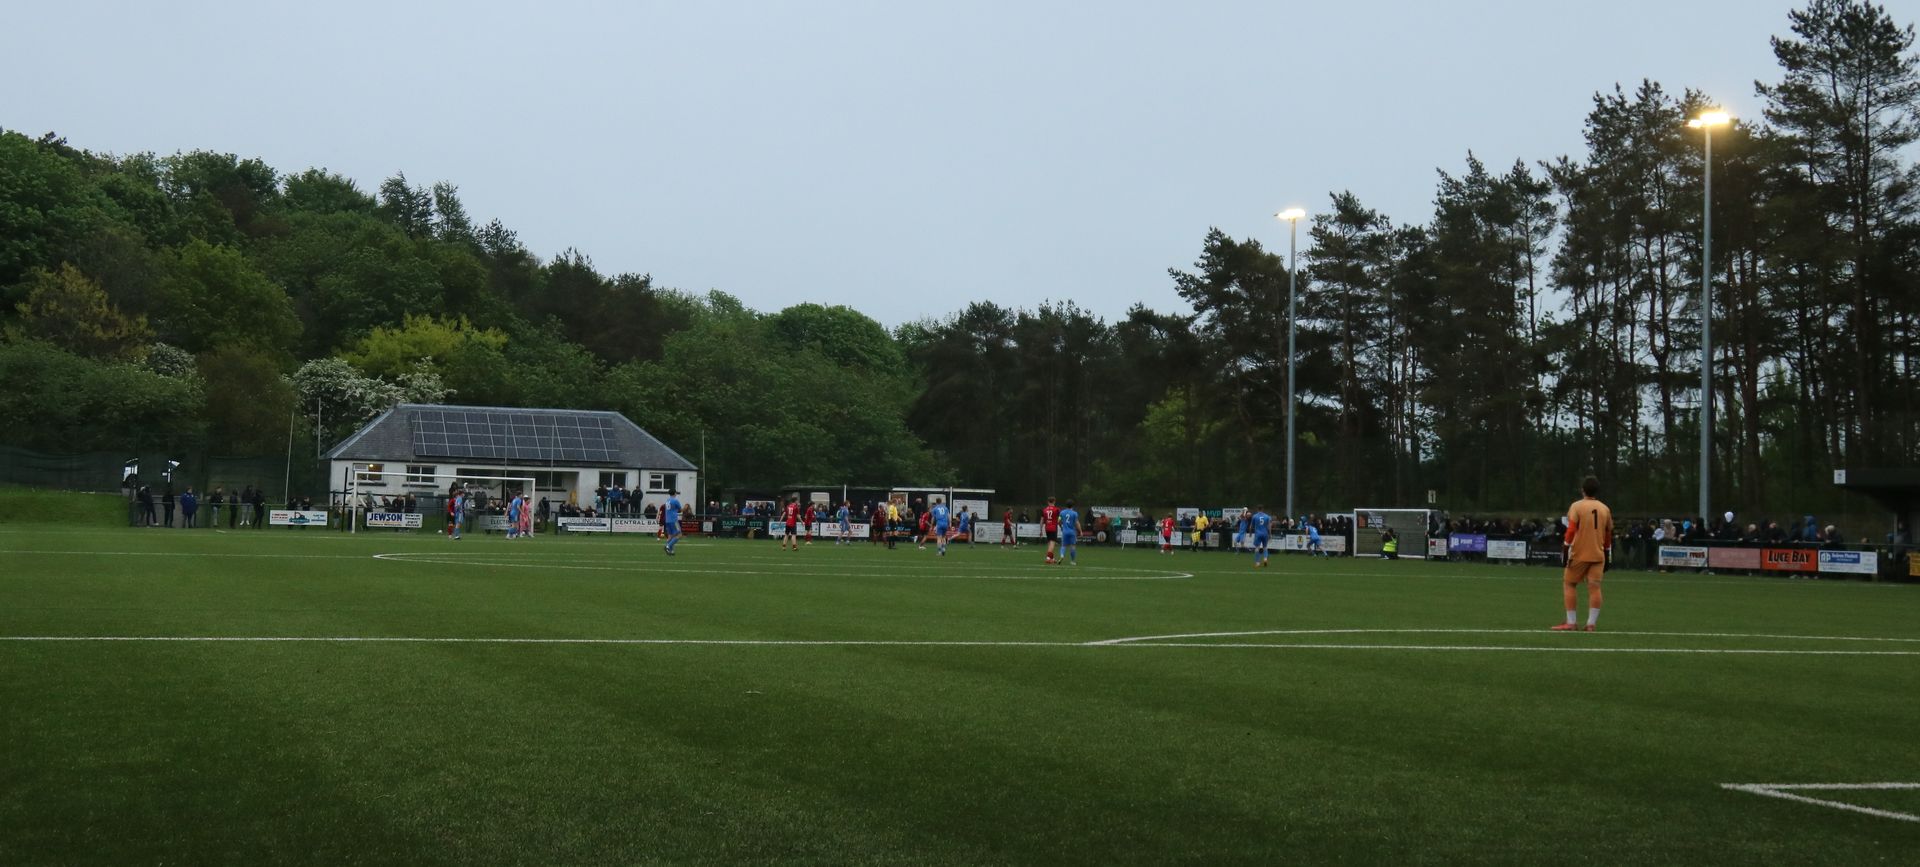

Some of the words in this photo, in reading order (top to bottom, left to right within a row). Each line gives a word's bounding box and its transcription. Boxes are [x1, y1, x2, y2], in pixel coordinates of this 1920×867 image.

[369, 513, 402, 521] JEWSON
[1046, 510, 1053, 520] 12
[1065, 514, 1070, 523] 2
[1591, 509, 1598, 529] 1
[1259, 516, 1264, 525] 5
[1768, 549, 1791, 562] LUCE
[1792, 550, 1811, 563] BAY
